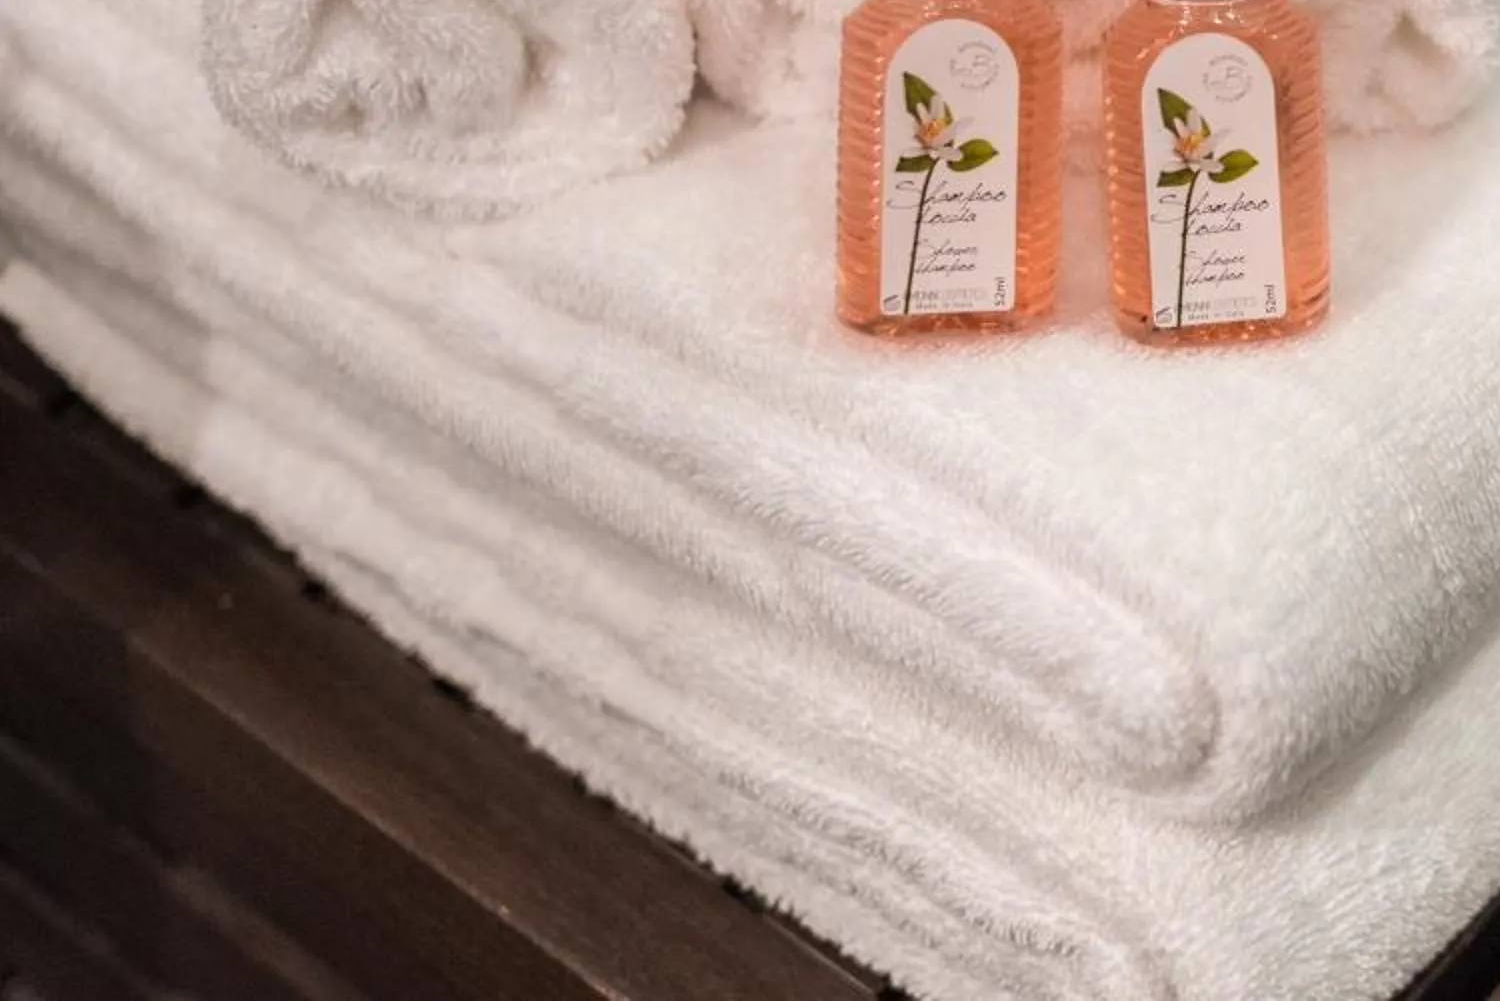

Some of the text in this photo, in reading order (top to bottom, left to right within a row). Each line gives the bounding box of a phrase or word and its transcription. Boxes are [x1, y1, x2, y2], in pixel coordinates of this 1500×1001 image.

[886, 180, 1008, 211] Shampoo
[1151, 191, 1271, 224] Shampoo
[1264, 284, 1278, 314] 52ml
